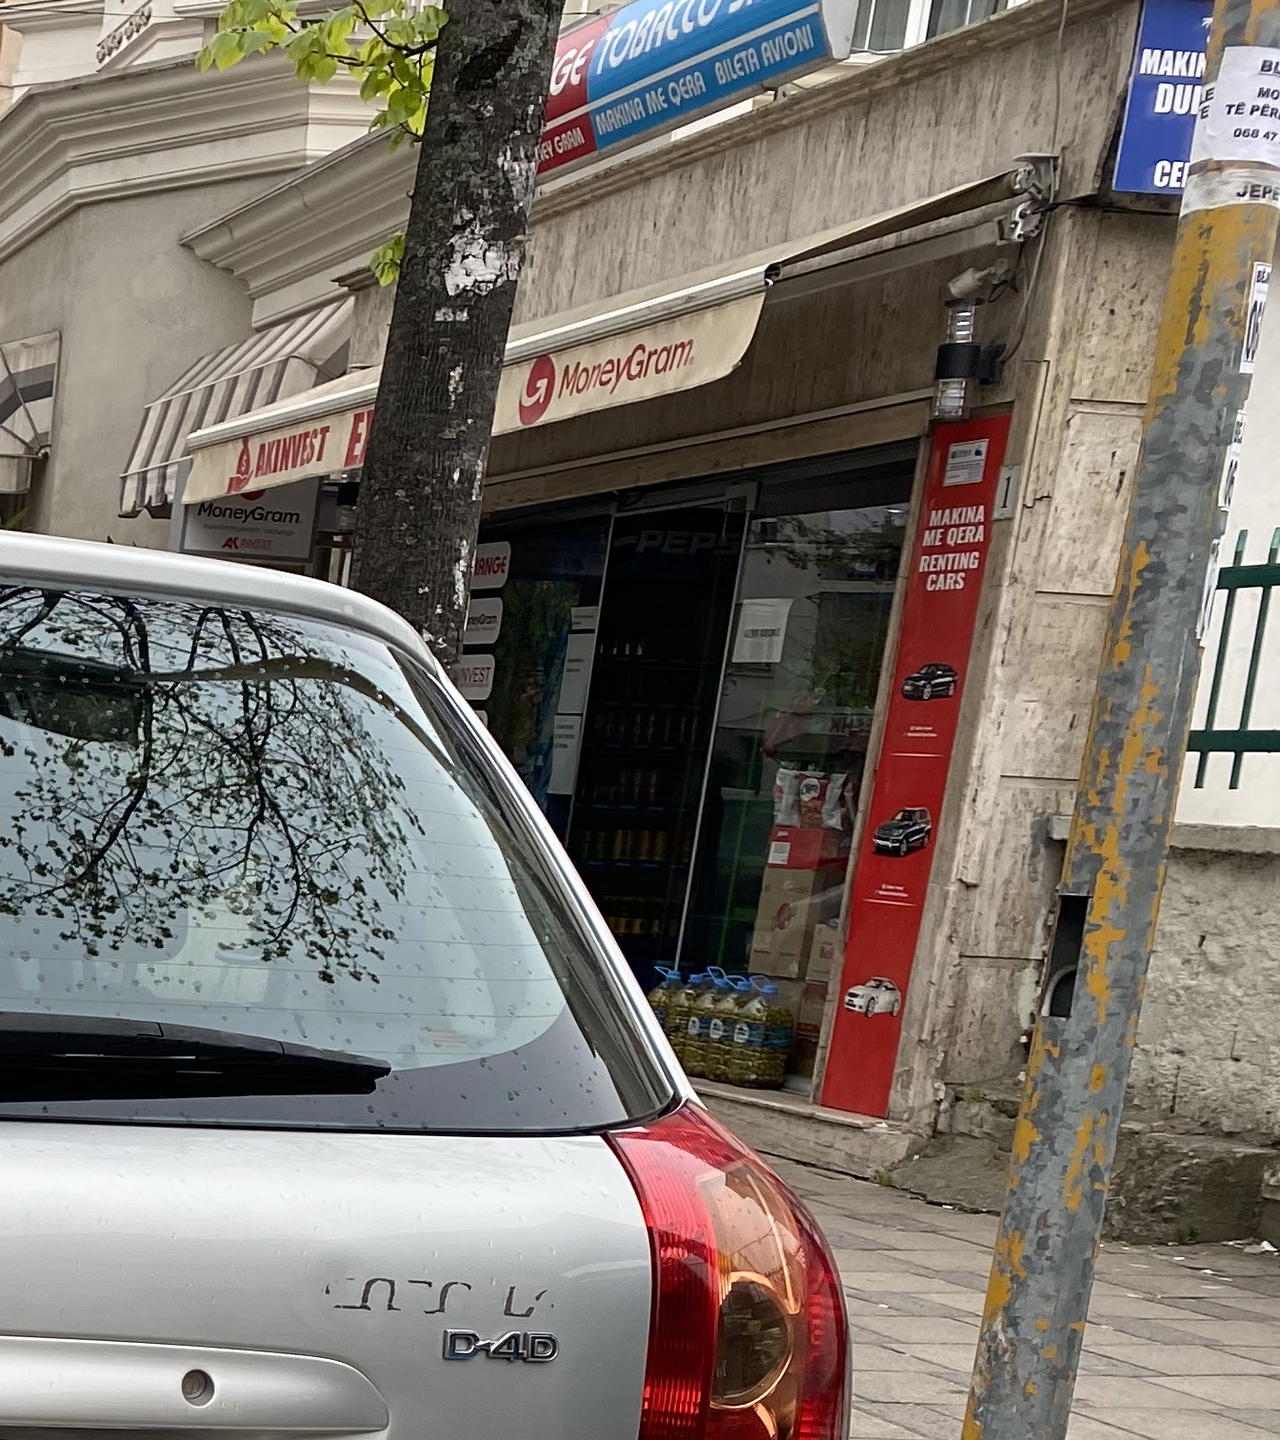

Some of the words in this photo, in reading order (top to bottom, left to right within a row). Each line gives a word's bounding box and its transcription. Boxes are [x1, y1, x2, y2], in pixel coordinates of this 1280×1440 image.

[596, 0, 721, 75] TOBACCO
[551, 38, 594, 96] GE
[596, 100, 646, 136] MAKINA
[646, 89, 666, 115] ME
[668, 71, 706, 107] QERA
[714, 46, 760, 84] BILETA
[761, 23, 815, 68] AVIONI
[554, 126, 585, 154] GRAM
[558, 341, 694, 399] MoneyGram
[254, 425, 330, 477] AKINVEST
[197, 502, 300, 525] MoneyGram
[929, 505, 985, 527] MAKINA
[922, 528, 943, 547] ME
[946, 525, 984, 546] QERA
[919, 551, 980, 573] RENTING
[926, 572, 966, 592] CARS
[468, 613, 498, 625] neyGram
[443, 1328, 560, 1363] D-4D
